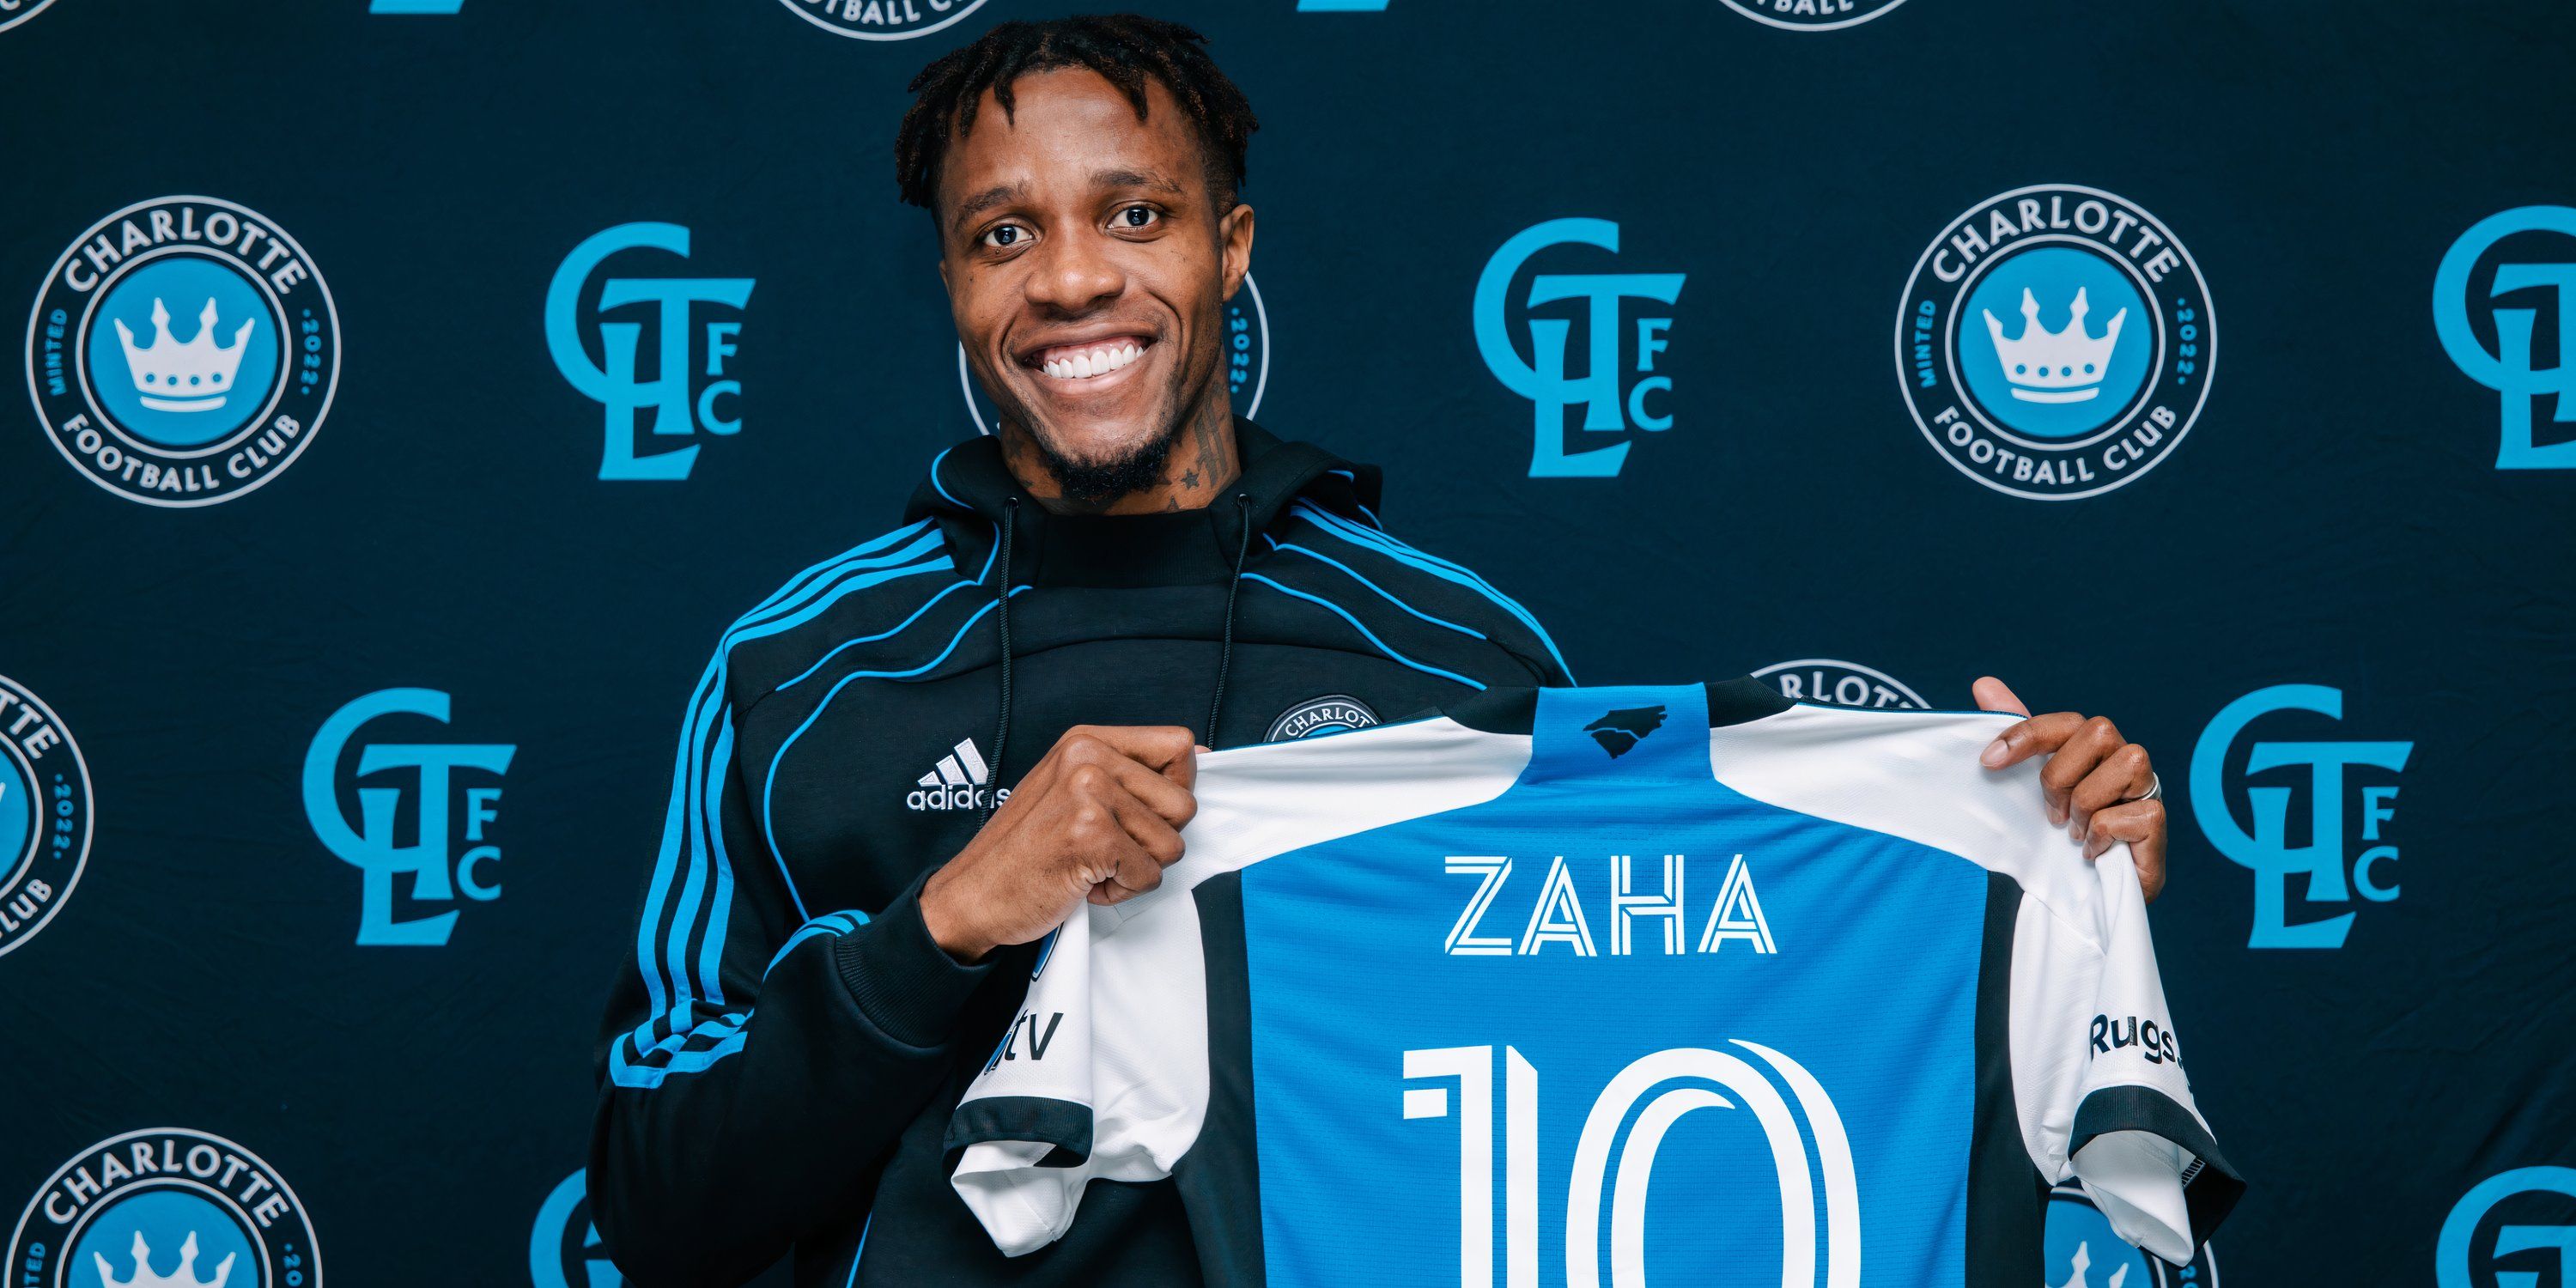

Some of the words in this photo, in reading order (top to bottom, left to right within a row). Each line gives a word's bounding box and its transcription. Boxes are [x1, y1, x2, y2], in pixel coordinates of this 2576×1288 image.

[65, 207, 307, 294] CHARLOTTE
[1933, 196, 2181, 283] CHARLOTTE
[46, 309, 67, 396] MINTED
[1915, 301, 1937, 387] MINTED
[63, 414, 220, 492] FOOTBALL
[228, 415, 301, 478] CLUB
[1934, 406, 2095, 485] FOOTBALL
[2104, 405, 2177, 471] CLUB
[1779, 671, 1914, 708] RLOT
[0, 879, 52, 939] LUB
[1445, 854, 1777, 957] ZAHA
[45, 1139, 290, 1227] CHARLOTTE
[1402, 1038, 1862, 1288] 10
